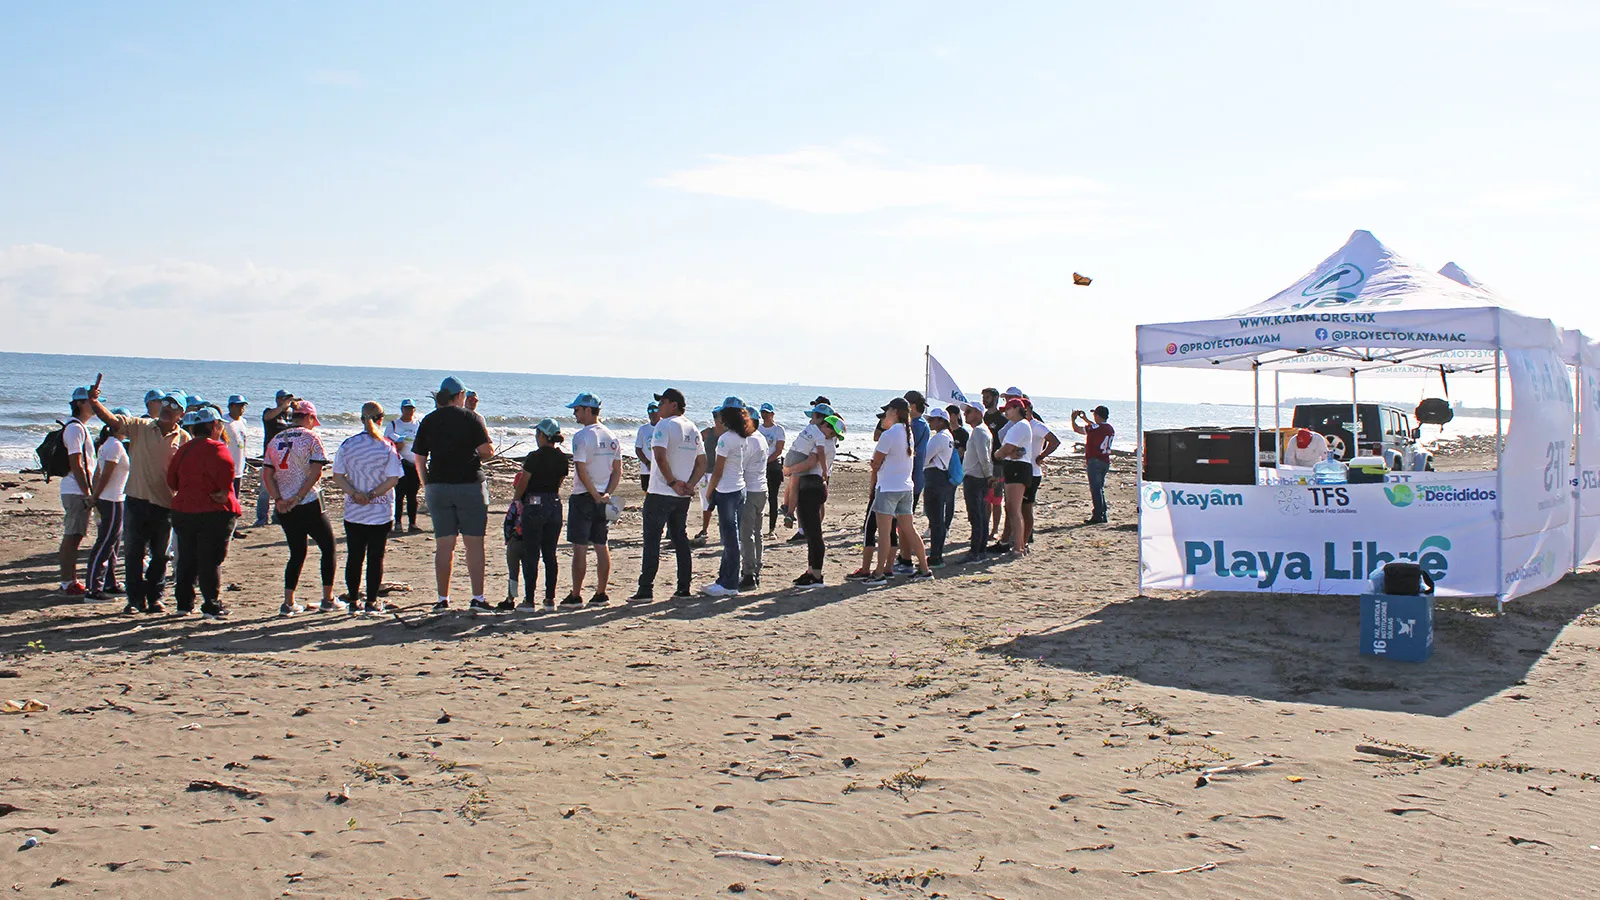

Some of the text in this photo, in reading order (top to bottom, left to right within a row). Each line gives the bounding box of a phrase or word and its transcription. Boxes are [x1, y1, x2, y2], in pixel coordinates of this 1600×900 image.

[1239, 313, 1376, 329] WWW.KAYAM.ORG.MX
[1179, 333, 1281, 355] @PROYECTOKAYAM
[1331, 330, 1467, 342] @PROYECTOKAYAMAC
[278, 441, 294, 470] 7
[1308, 487, 1350, 507] TFS
[1416, 484, 1453, 492] Somos
[1184, 540, 1312, 589] Playa
[1373, 640, 1387, 655] 16
